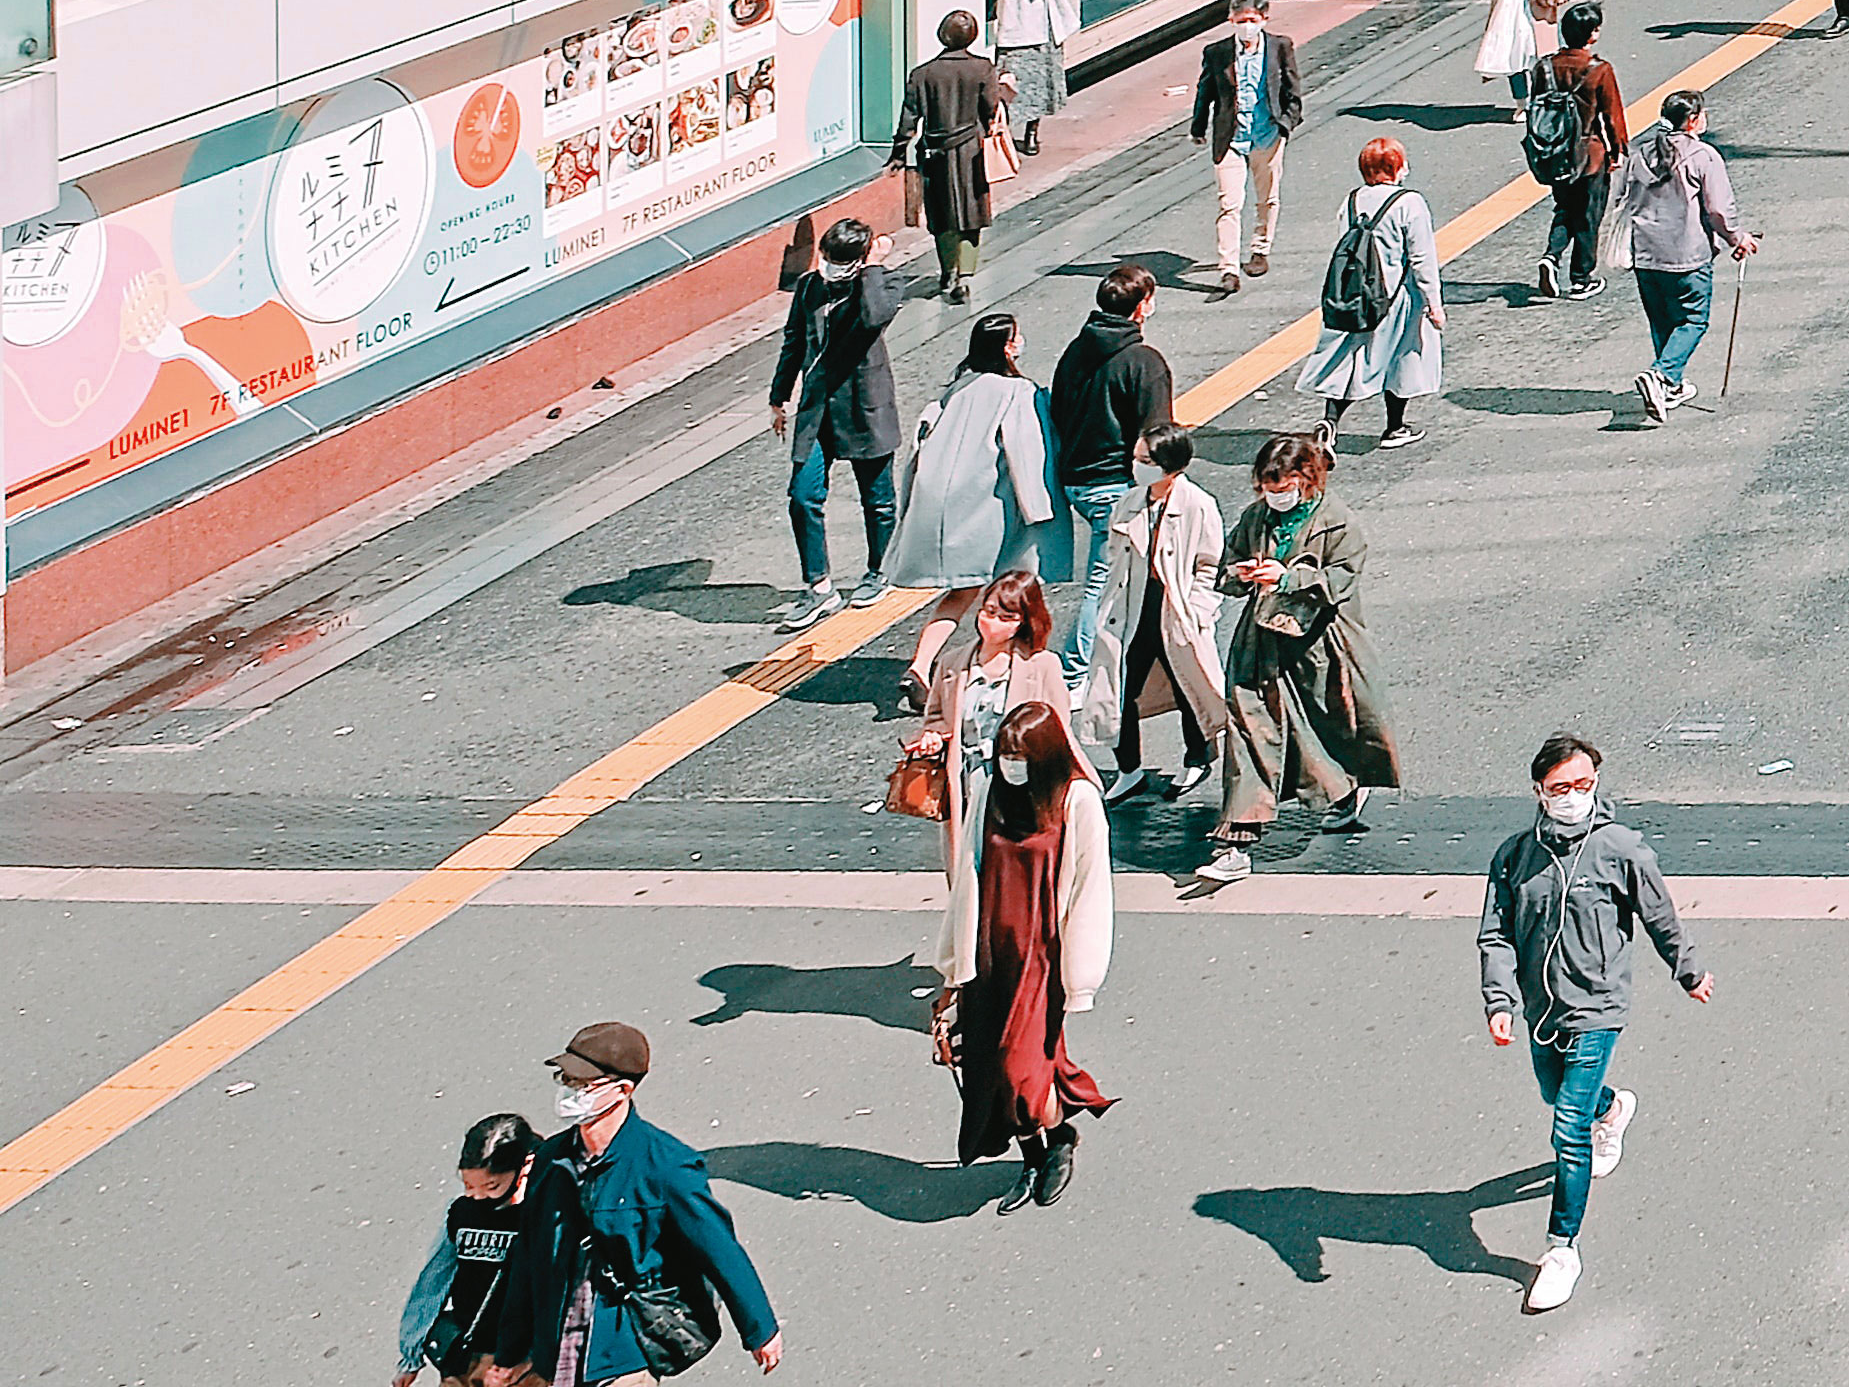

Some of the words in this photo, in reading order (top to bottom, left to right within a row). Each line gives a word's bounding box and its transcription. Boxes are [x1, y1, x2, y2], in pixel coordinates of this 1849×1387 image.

[440, 206, 482, 233] OPENING
[485, 194, 516, 213] HOURS
[622, 214, 639, 234] 7F
[643, 180, 729, 224] RESTAURANT
[732, 152, 777, 187] FLOOR
[309, 198, 399, 277] KITCHEN
[3, 283, 70, 298] KITCHEN
[109, 408, 189, 460] LUMINE1
[210, 391, 232, 416] 7F
[238, 339, 351, 404] RESTAURANT
[355, 312, 413, 352] FLOOR
